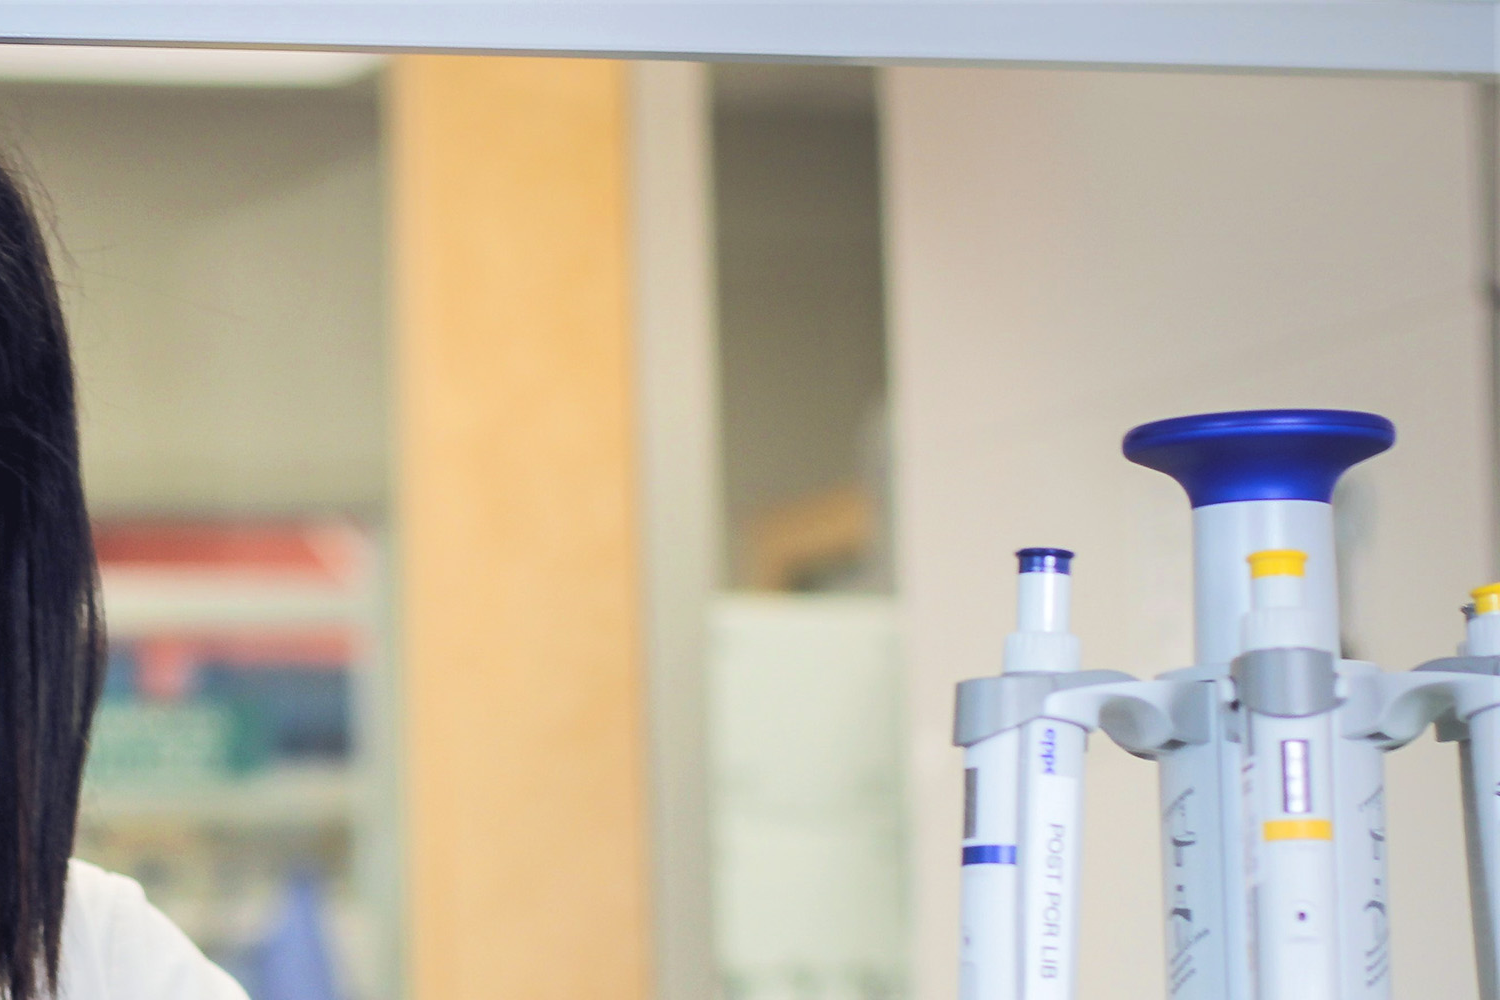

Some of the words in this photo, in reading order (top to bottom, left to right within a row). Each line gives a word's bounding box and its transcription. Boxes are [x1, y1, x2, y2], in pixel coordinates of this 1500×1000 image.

[1046, 822, 1066, 883] POST
[1043, 890, 1061, 937] PCR
[1040, 945, 1059, 979] LIB
